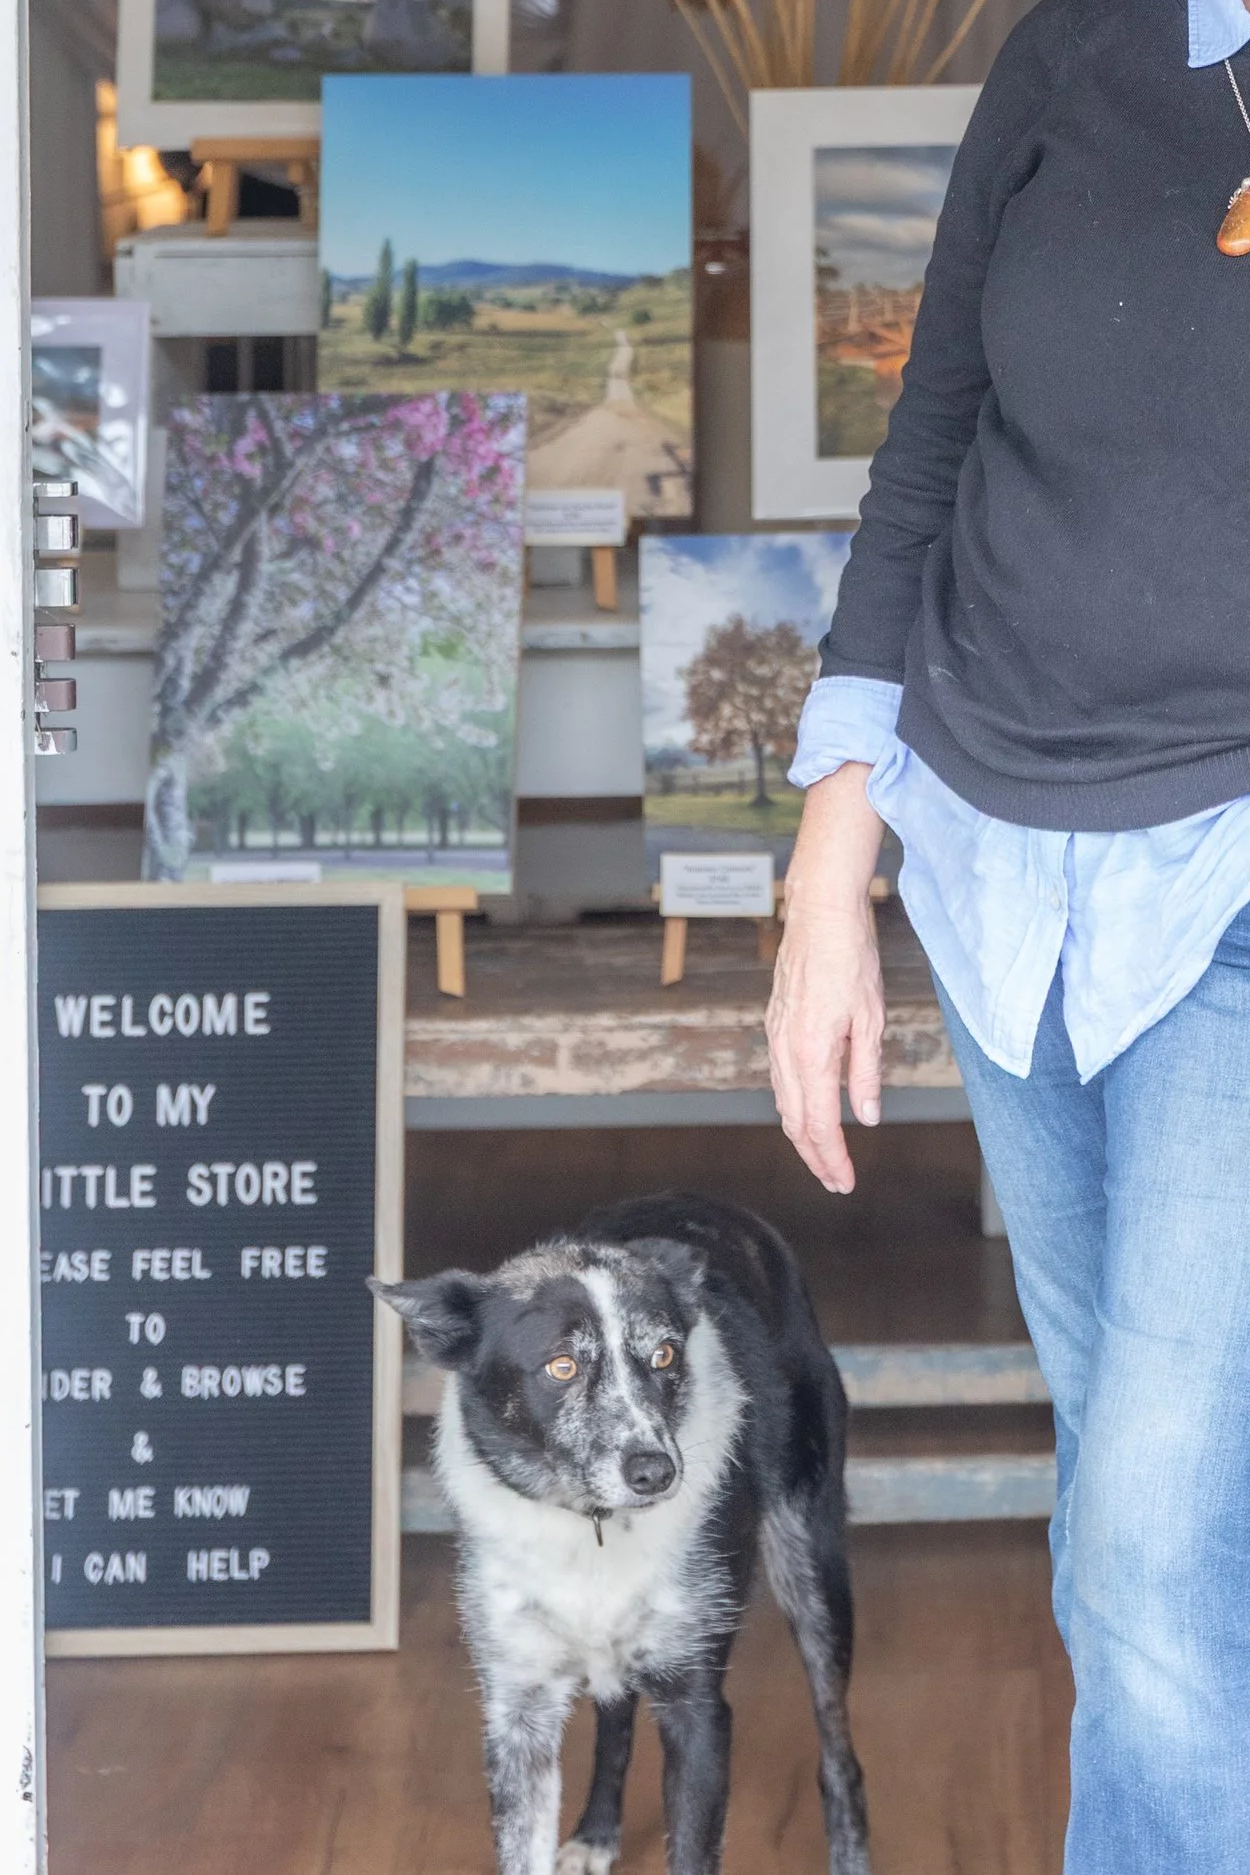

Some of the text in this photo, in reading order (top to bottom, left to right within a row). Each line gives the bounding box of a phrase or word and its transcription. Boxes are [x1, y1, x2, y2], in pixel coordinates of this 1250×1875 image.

[54, 992, 271, 1038] WELCOME
[81, 1083, 217, 1127] TO MY
[41, 1161, 318, 1210] ITTLE STORE
[40, 1245, 328, 1283] EASE FEEL FREE
[125, 1312, 167, 1346] TO
[42, 1364, 307, 1402] DER & BROWSE
[130, 1431, 154, 1465] &
[44, 1484, 250, 1522] ET ME KNOW
[51, 1547, 271, 1585] I CAN HELP
